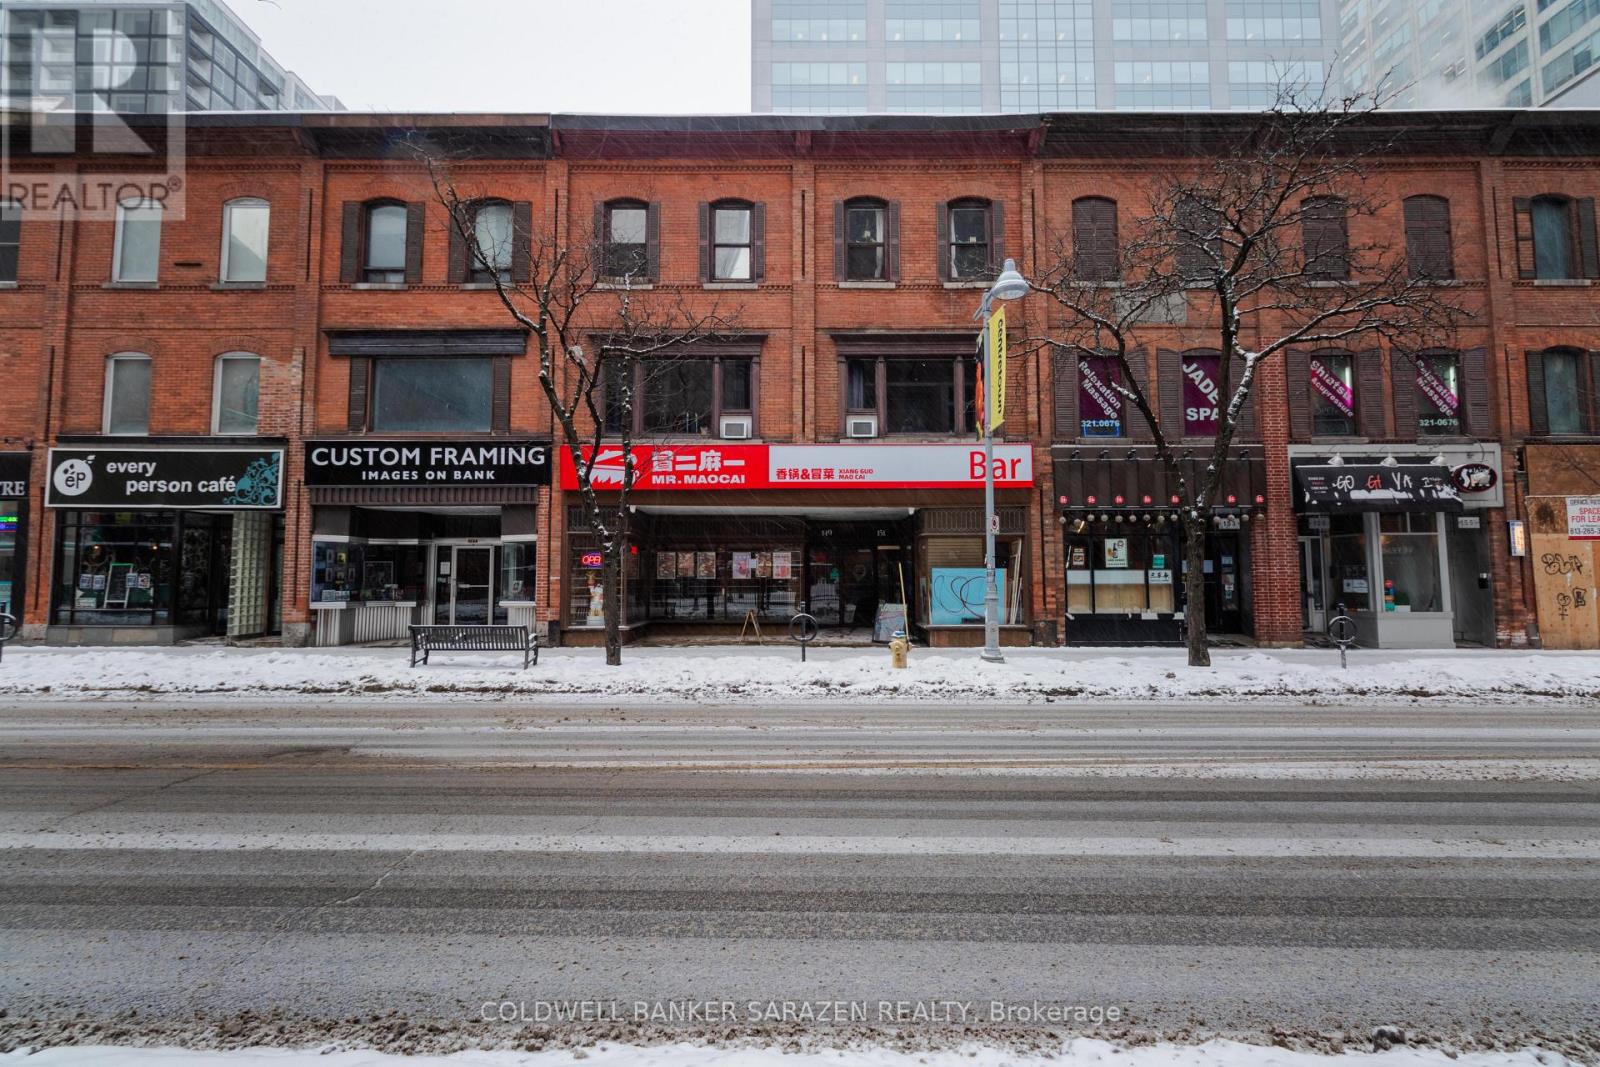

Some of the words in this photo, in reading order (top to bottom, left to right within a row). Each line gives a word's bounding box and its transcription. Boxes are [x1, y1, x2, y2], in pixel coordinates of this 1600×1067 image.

[1079, 361, 1121, 409] Relaxation
[1081, 378, 1118, 419] Massage
[311, 447, 420, 466] CUSTOM
[430, 447, 546, 466] FRAMING
[970, 451, 1021, 479] Bar
[106, 461, 156, 477] every
[362, 470, 419, 481] IMAGES
[425, 470, 447, 481] ON
[454, 470, 496, 481] BANK
[126, 480, 192, 495] person
[197, 475, 236, 493] café
[684, 474, 746, 484] MAOCAI
[0, 481, 25, 496] RE
[1571, 515, 1585, 523] FOR
